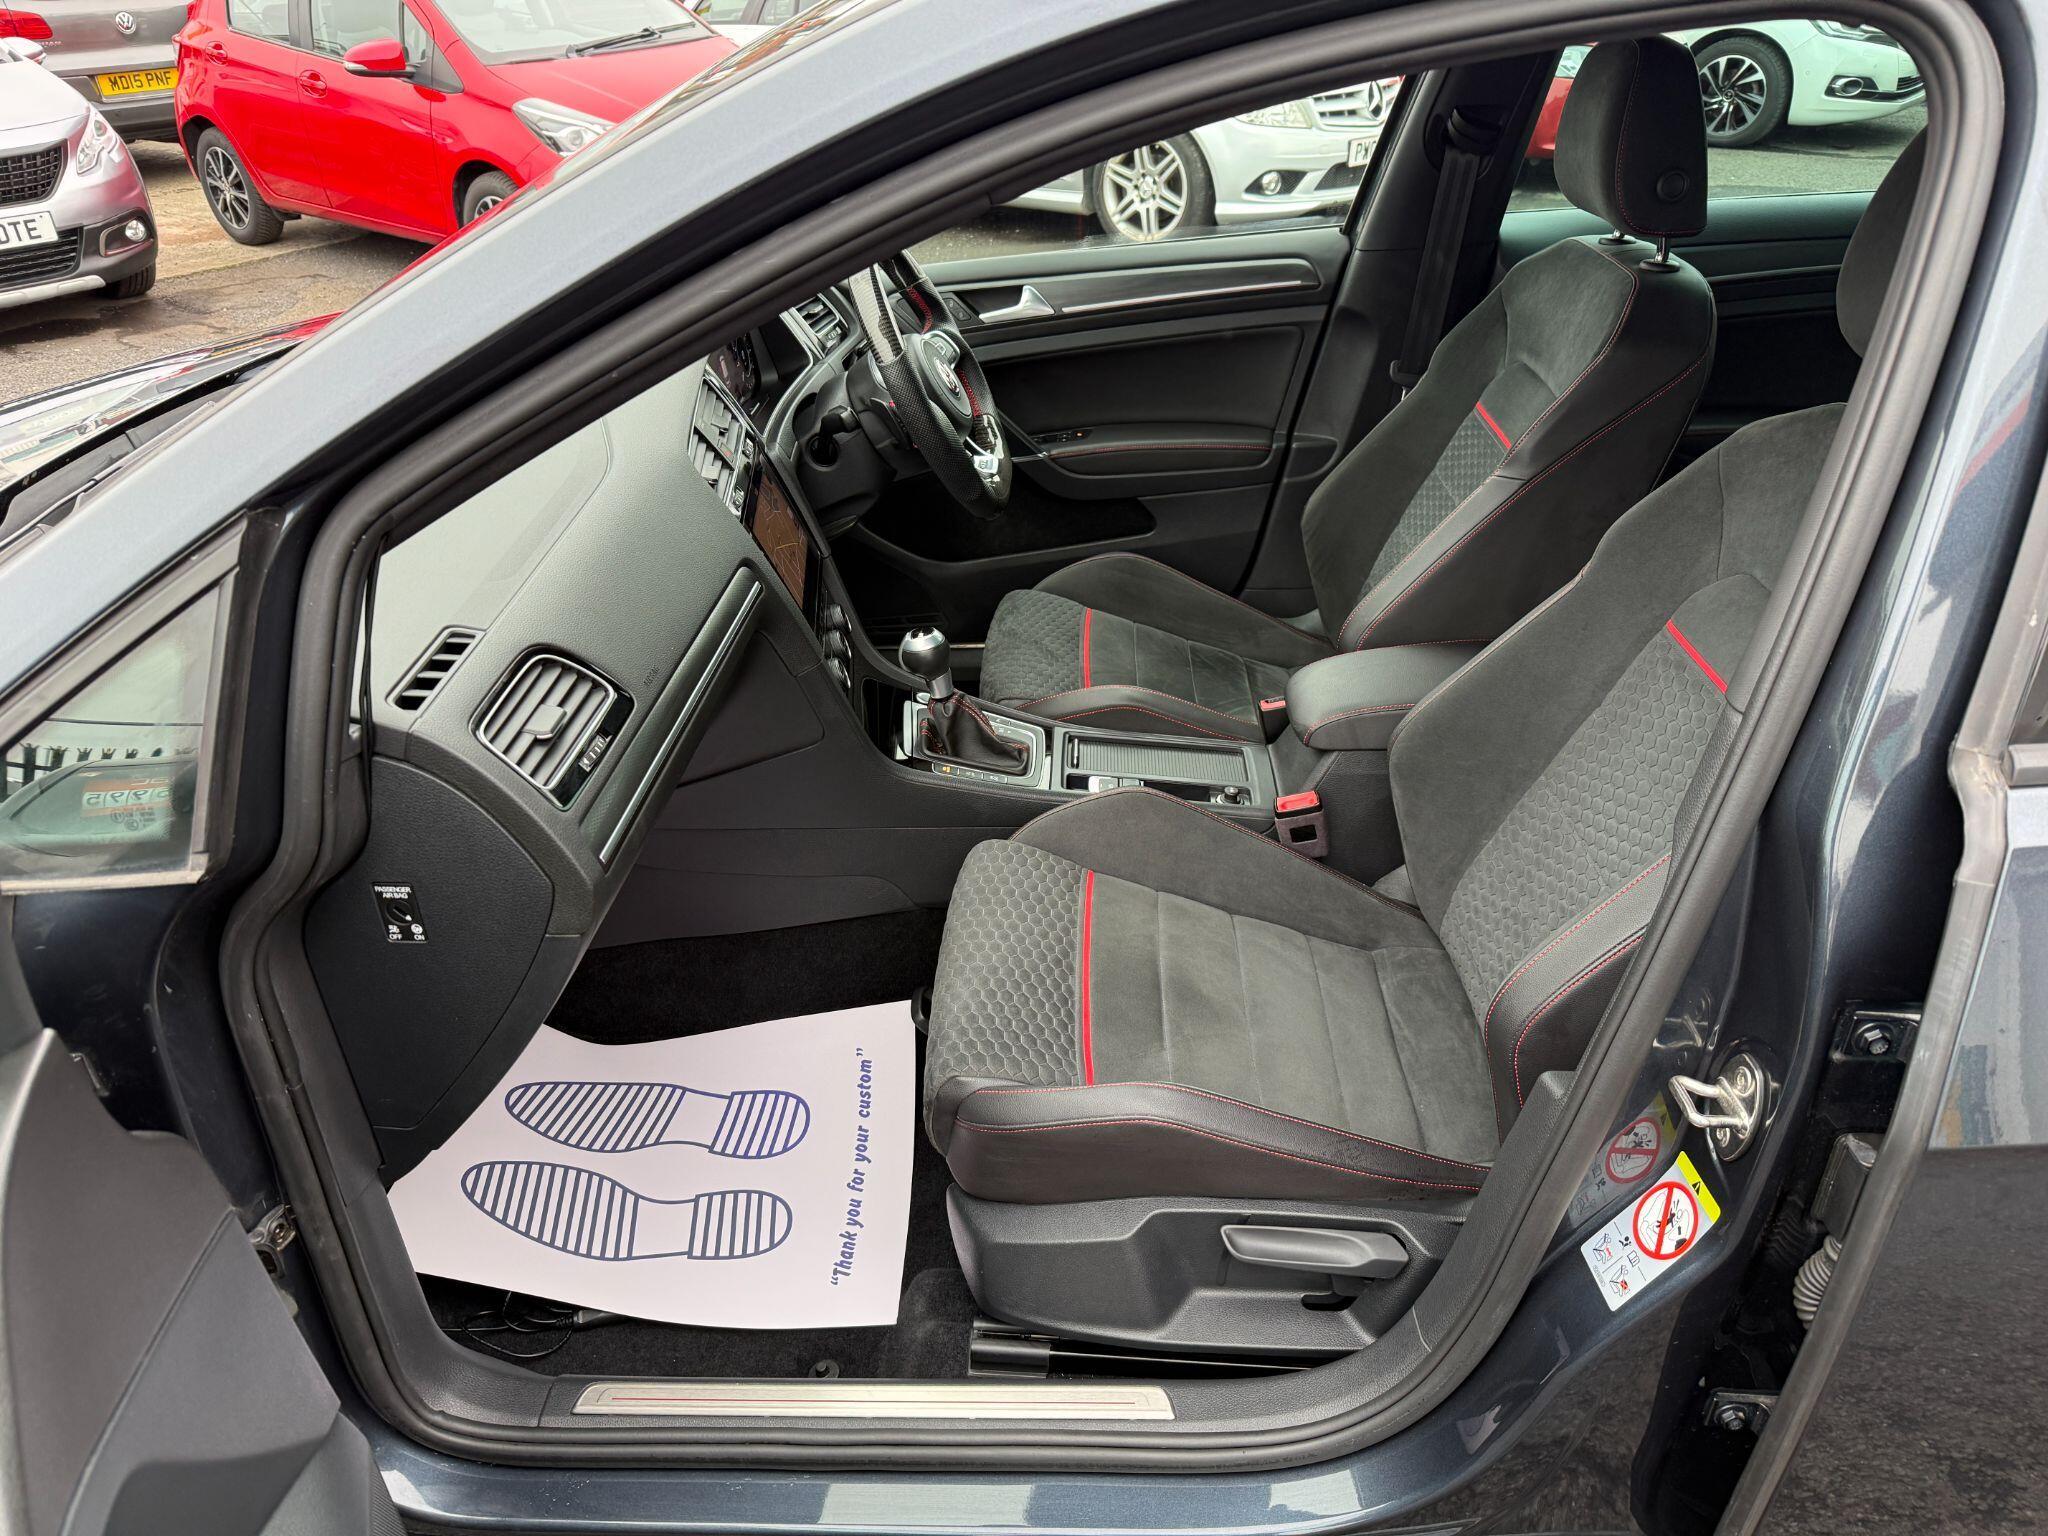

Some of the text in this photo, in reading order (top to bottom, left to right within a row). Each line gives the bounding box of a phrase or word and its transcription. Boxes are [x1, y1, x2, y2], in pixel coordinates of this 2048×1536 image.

[146, 71, 172, 88] PNF
[854, 1125, 872, 1164] your
[846, 1168, 865, 1192] for
[846, 1198, 865, 1229] you
